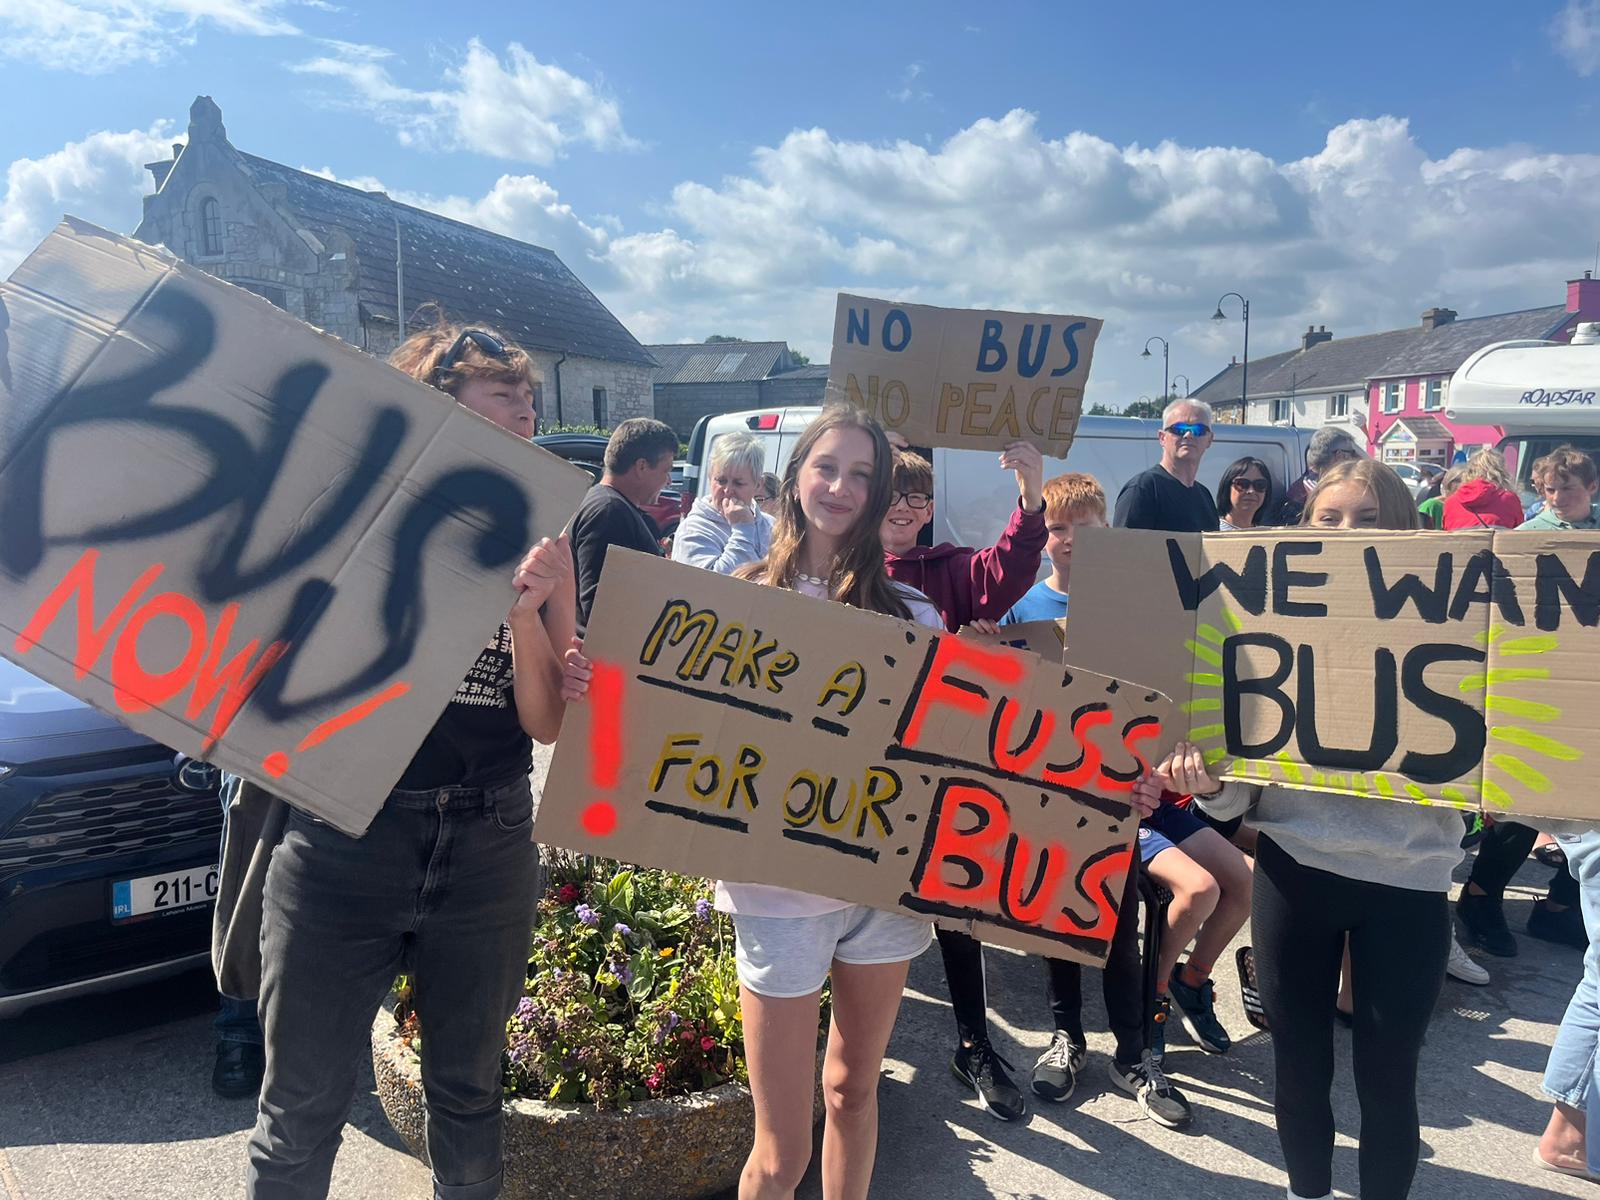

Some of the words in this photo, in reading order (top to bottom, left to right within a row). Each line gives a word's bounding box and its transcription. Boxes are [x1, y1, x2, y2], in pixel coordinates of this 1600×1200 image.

[846, 308, 911, 352] NO
[976, 319, 1086, 378] BUS
[844, 372, 910, 429] NO
[935, 382, 1080, 441] PEACE
[1519, 388, 1596, 407] ROADSTAR
[0, 284, 533, 723] BUS
[1166, 538, 1328, 617] WE
[817, 660, 867, 716] A
[1223, 632, 1487, 784] BUS
[649, 733, 767, 812] FOR
[782, 766, 902, 839] OUR
[910, 777, 1133, 939] BUS
[114, 905, 131, 915] IRL
[154, 871, 218, 908] 211-C
